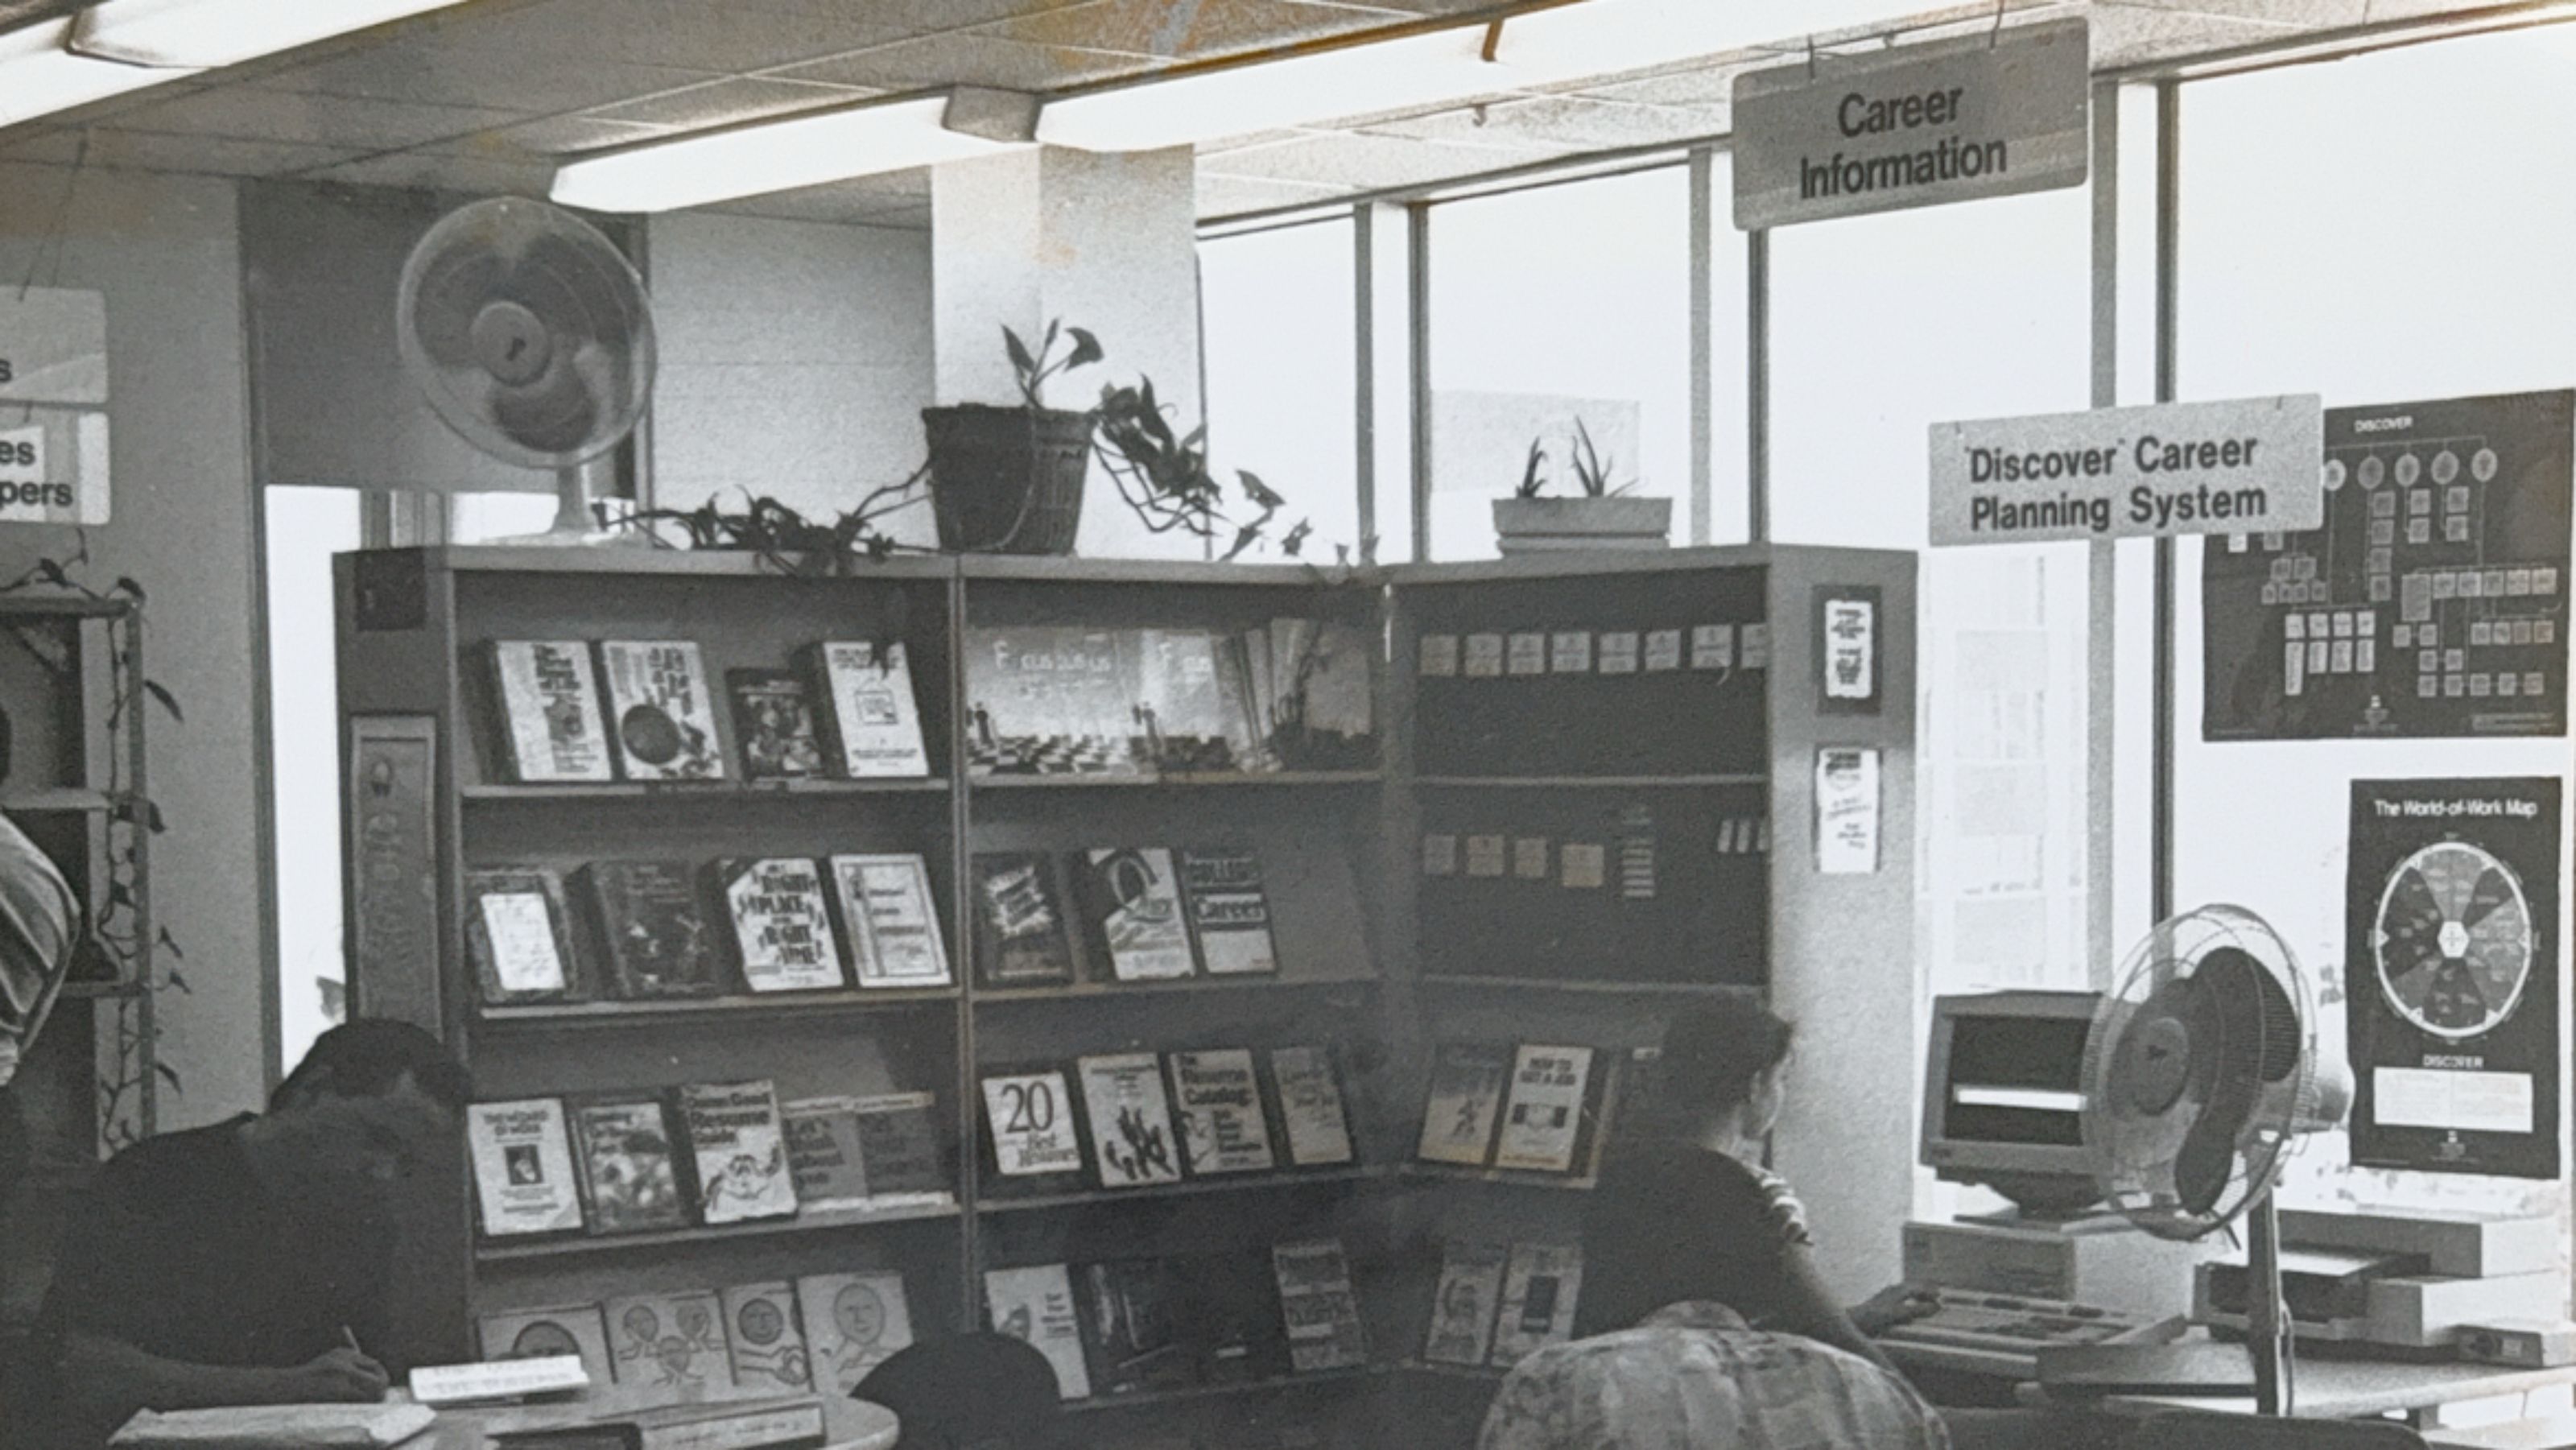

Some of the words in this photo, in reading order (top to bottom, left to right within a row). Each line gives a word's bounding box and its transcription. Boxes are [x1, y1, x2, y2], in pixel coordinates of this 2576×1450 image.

[1837, 86, 1963, 138] Career
[1800, 135, 2007, 199] Information
[2354, 415, 2413, 432] DISCOVER
[2135, 435, 2258, 473] Career
[1971, 492, 2111, 532] Planning
[2129, 482, 2267, 528] System
[2375, 798, 2401, 817] The
[2402, 798, 2503, 817] World-of-Work
[2504, 797, 2539, 820] Map
[2423, 1054, 2484, 1069] DISCOVER
[1001, 1080, 1054, 1134] 20
